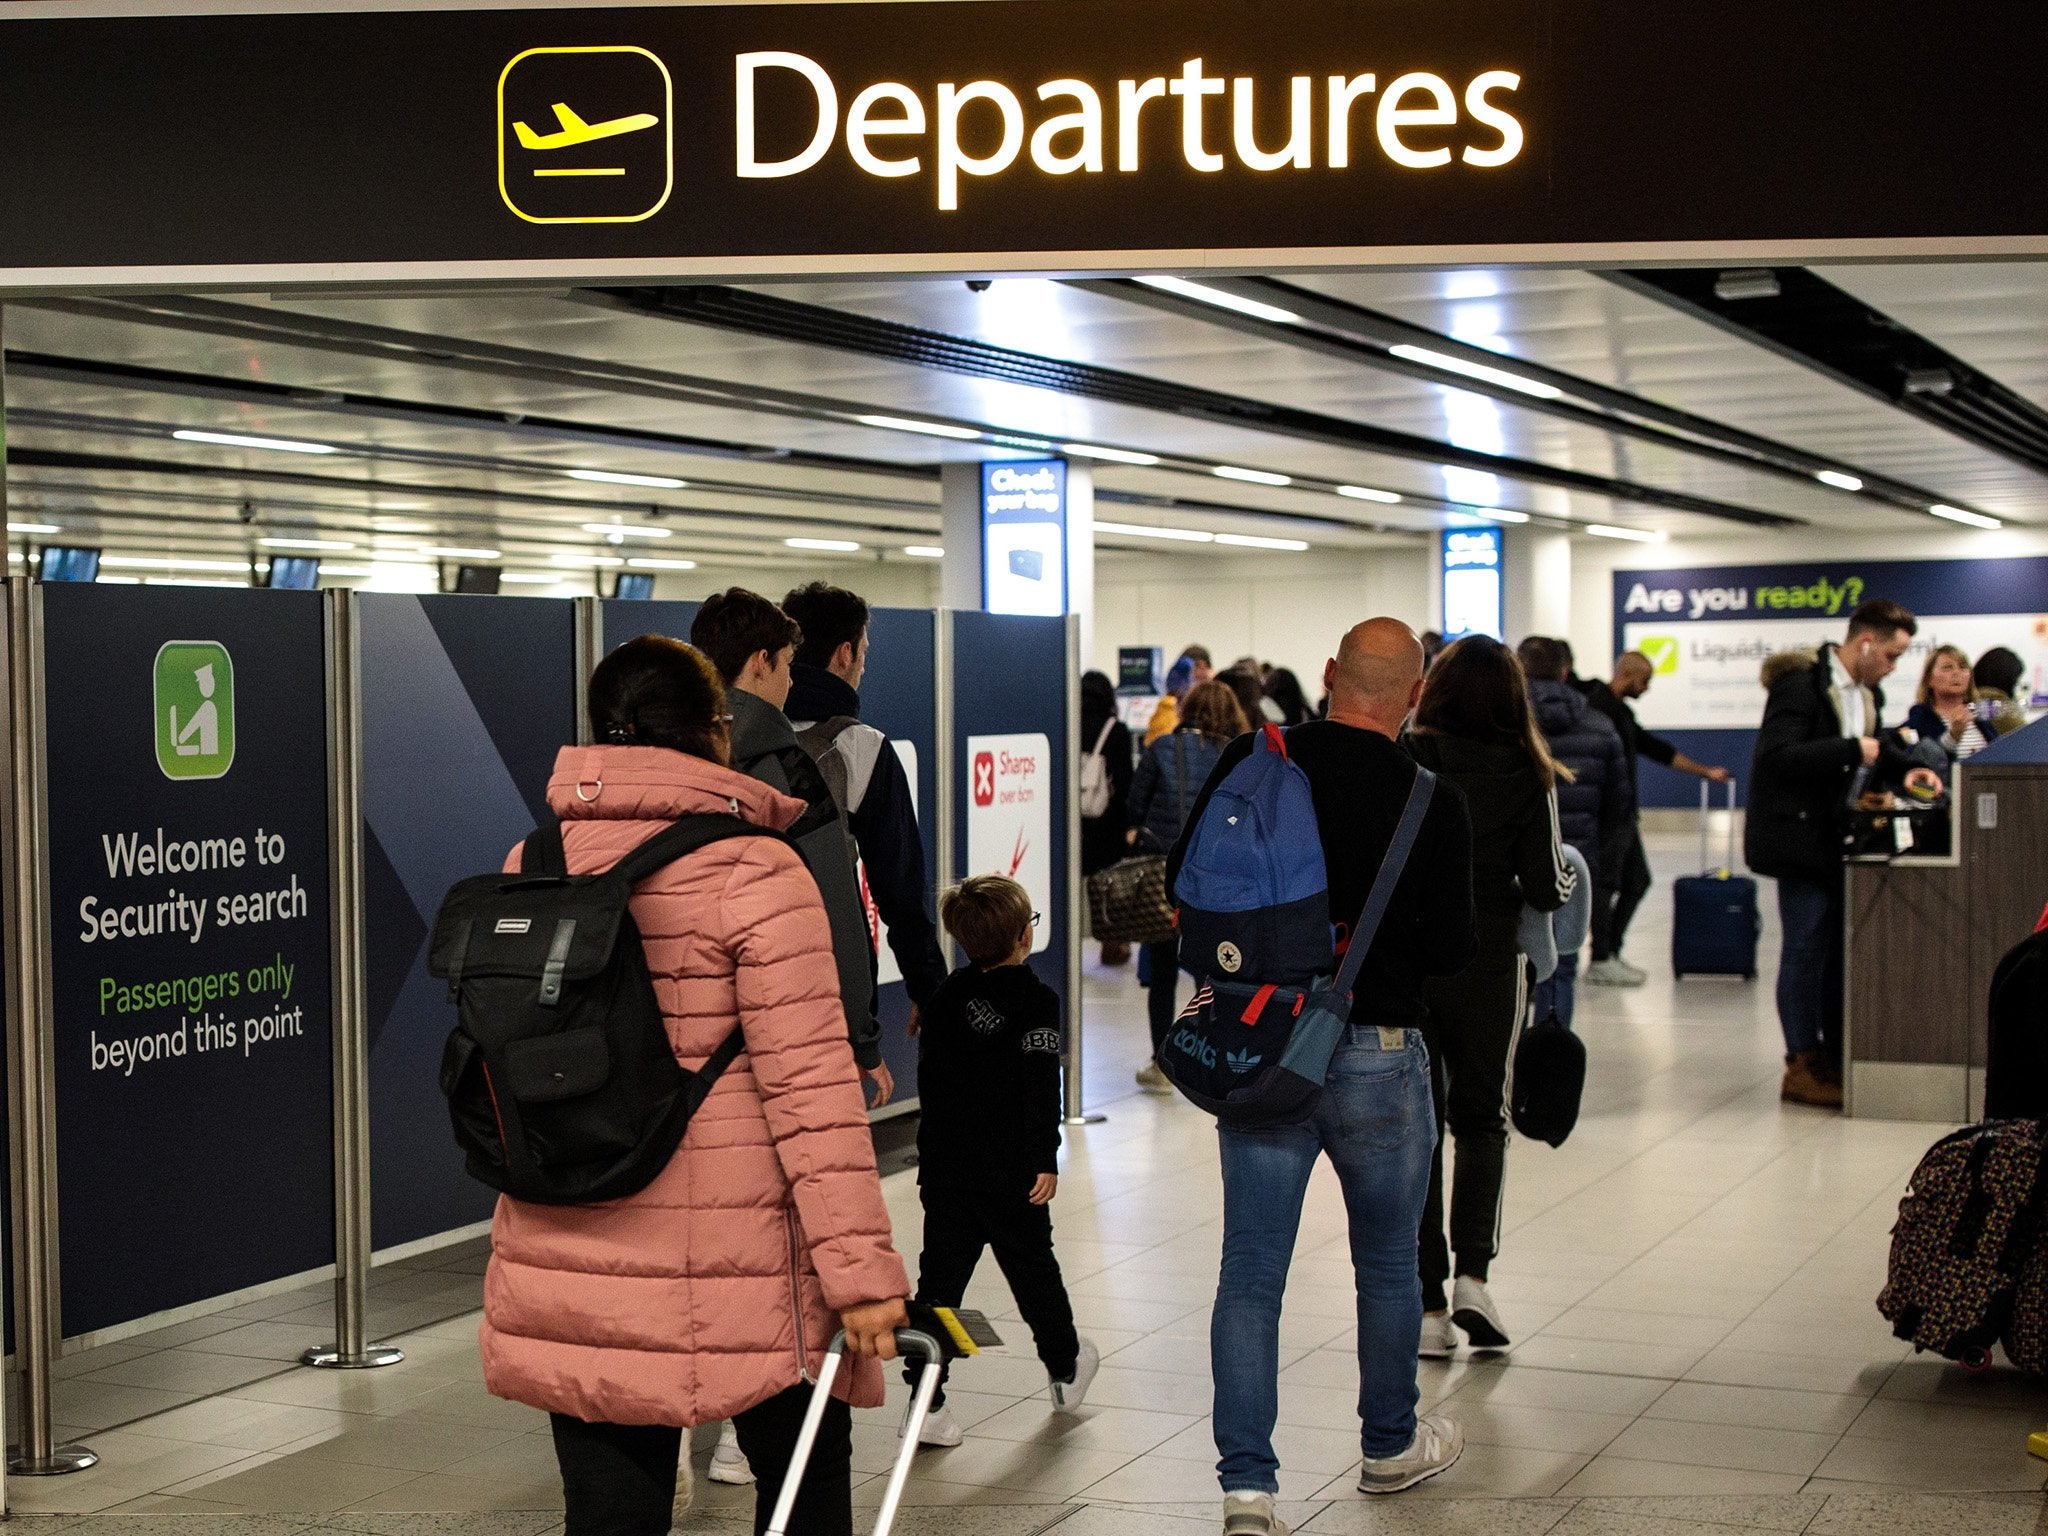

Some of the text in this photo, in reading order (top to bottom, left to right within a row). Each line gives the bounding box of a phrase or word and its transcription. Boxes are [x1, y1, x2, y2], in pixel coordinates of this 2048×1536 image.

[734, 50, 1526, 211] Departures
[1624, 576, 1864, 619] Are you ready?
[1690, 636, 1773, 667] Liquids
[999, 750, 1036, 779] Sharps
[102, 827, 286, 878] Welcome to
[80, 874, 307, 943] Security search
[99, 952, 295, 1015] Passengers only
[90, 1004, 303, 1077] beyond this point
